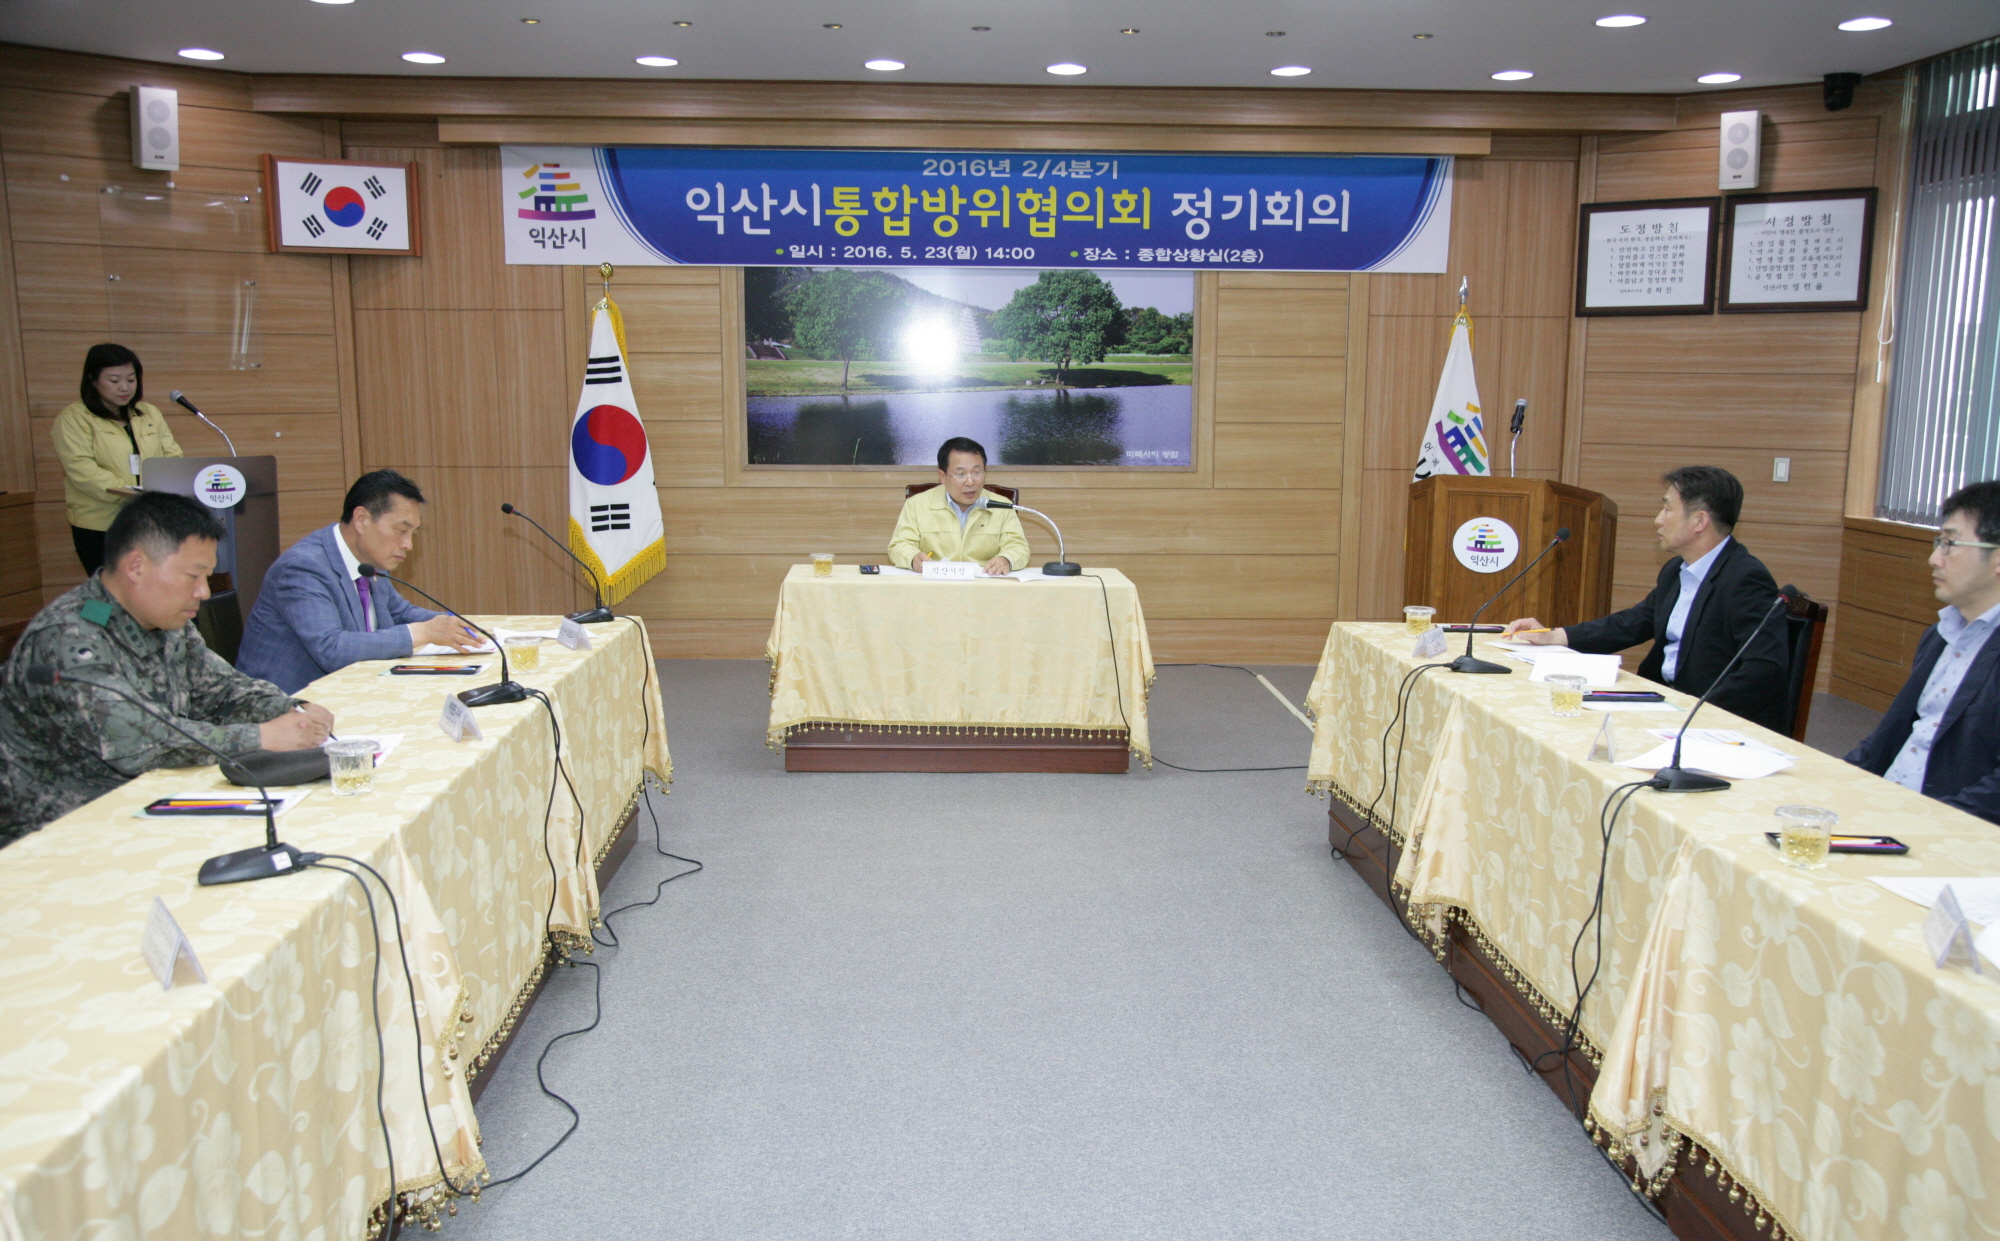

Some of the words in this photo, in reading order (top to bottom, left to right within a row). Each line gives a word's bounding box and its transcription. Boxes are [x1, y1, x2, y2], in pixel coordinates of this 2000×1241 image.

[922, 159, 1011, 178] 2016년
[1022, 160, 1119, 180] 2/4분기
[1171, 187, 1349, 240] 정기회의
[528, 227, 587, 250] 익산시
[789, 244, 823, 259] 일시
[844, 246, 893, 259] 2016.
[900, 246, 917, 259] 5.
[924, 245, 977, 261] 23(월)
[985, 247, 1035, 260] 14:00
[1084, 247, 1118, 262] 장소
[1137, 248, 1264, 264] 종합상황실(2층)
[210, 494, 233, 503] 익산시
[1470, 555, 1499, 567] 익산시
[932, 566, 966, 576] 익산시장
